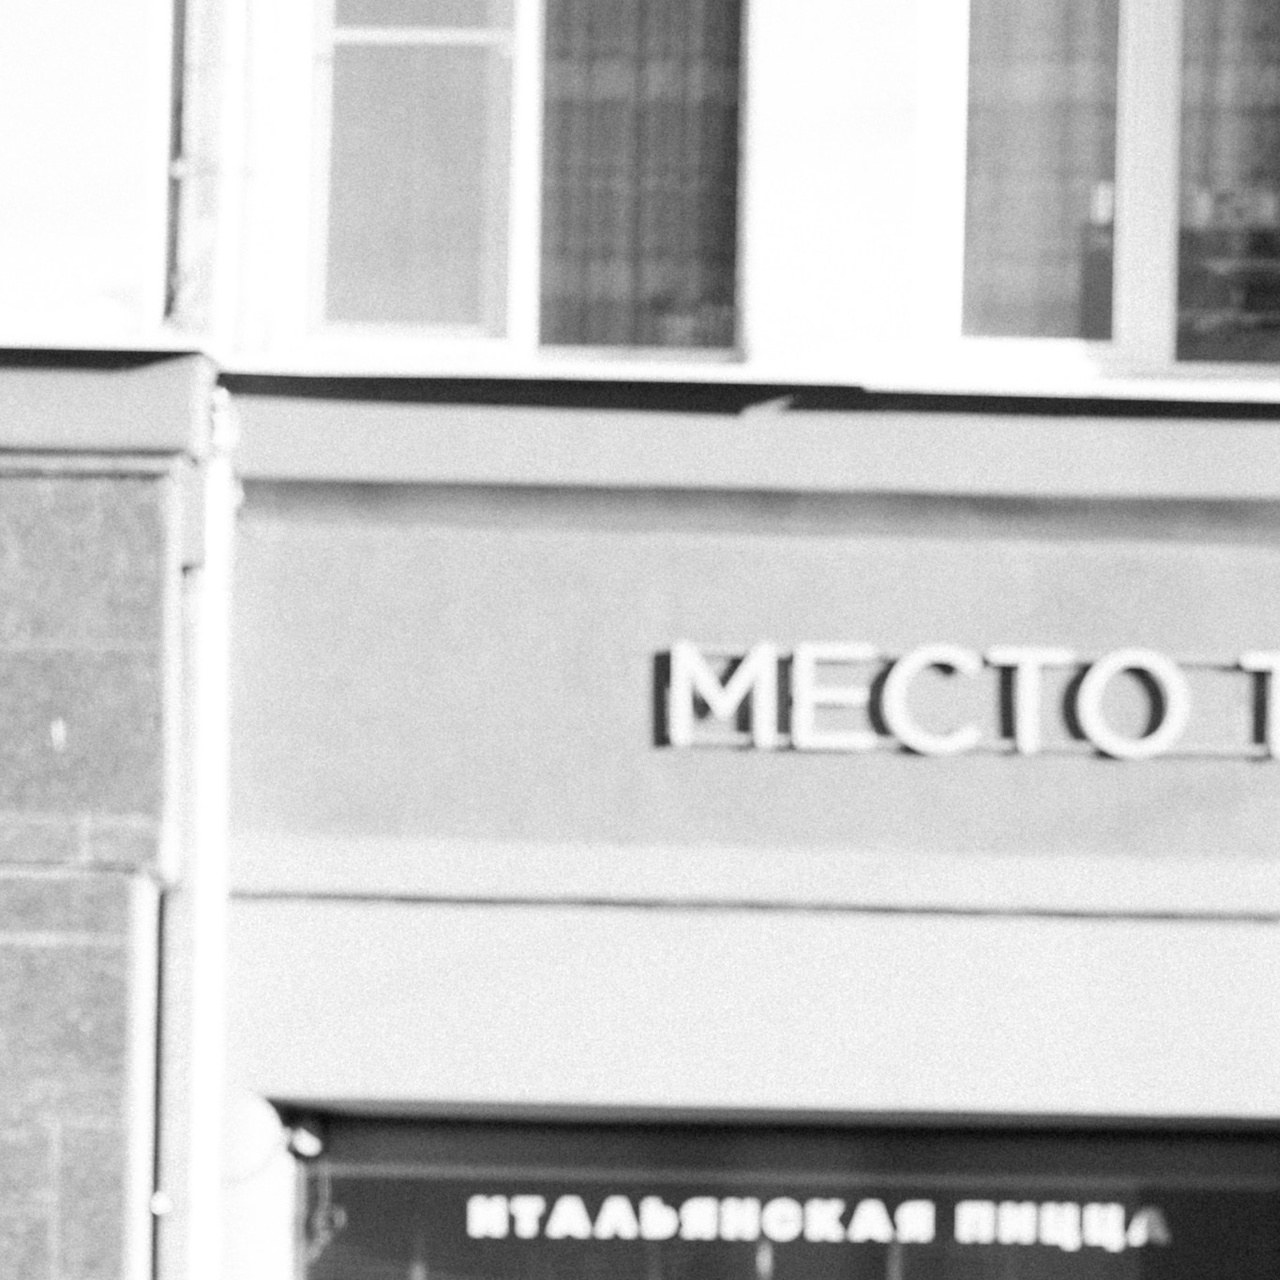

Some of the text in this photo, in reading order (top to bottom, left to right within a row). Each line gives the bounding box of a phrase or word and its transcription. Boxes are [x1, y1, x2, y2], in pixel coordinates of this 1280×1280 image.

[668, 638, 1193, 759] МЕСТО
[466, 1194, 1170, 1253] ИТАЛЬЯНСКАЯ ПИЦЦА
